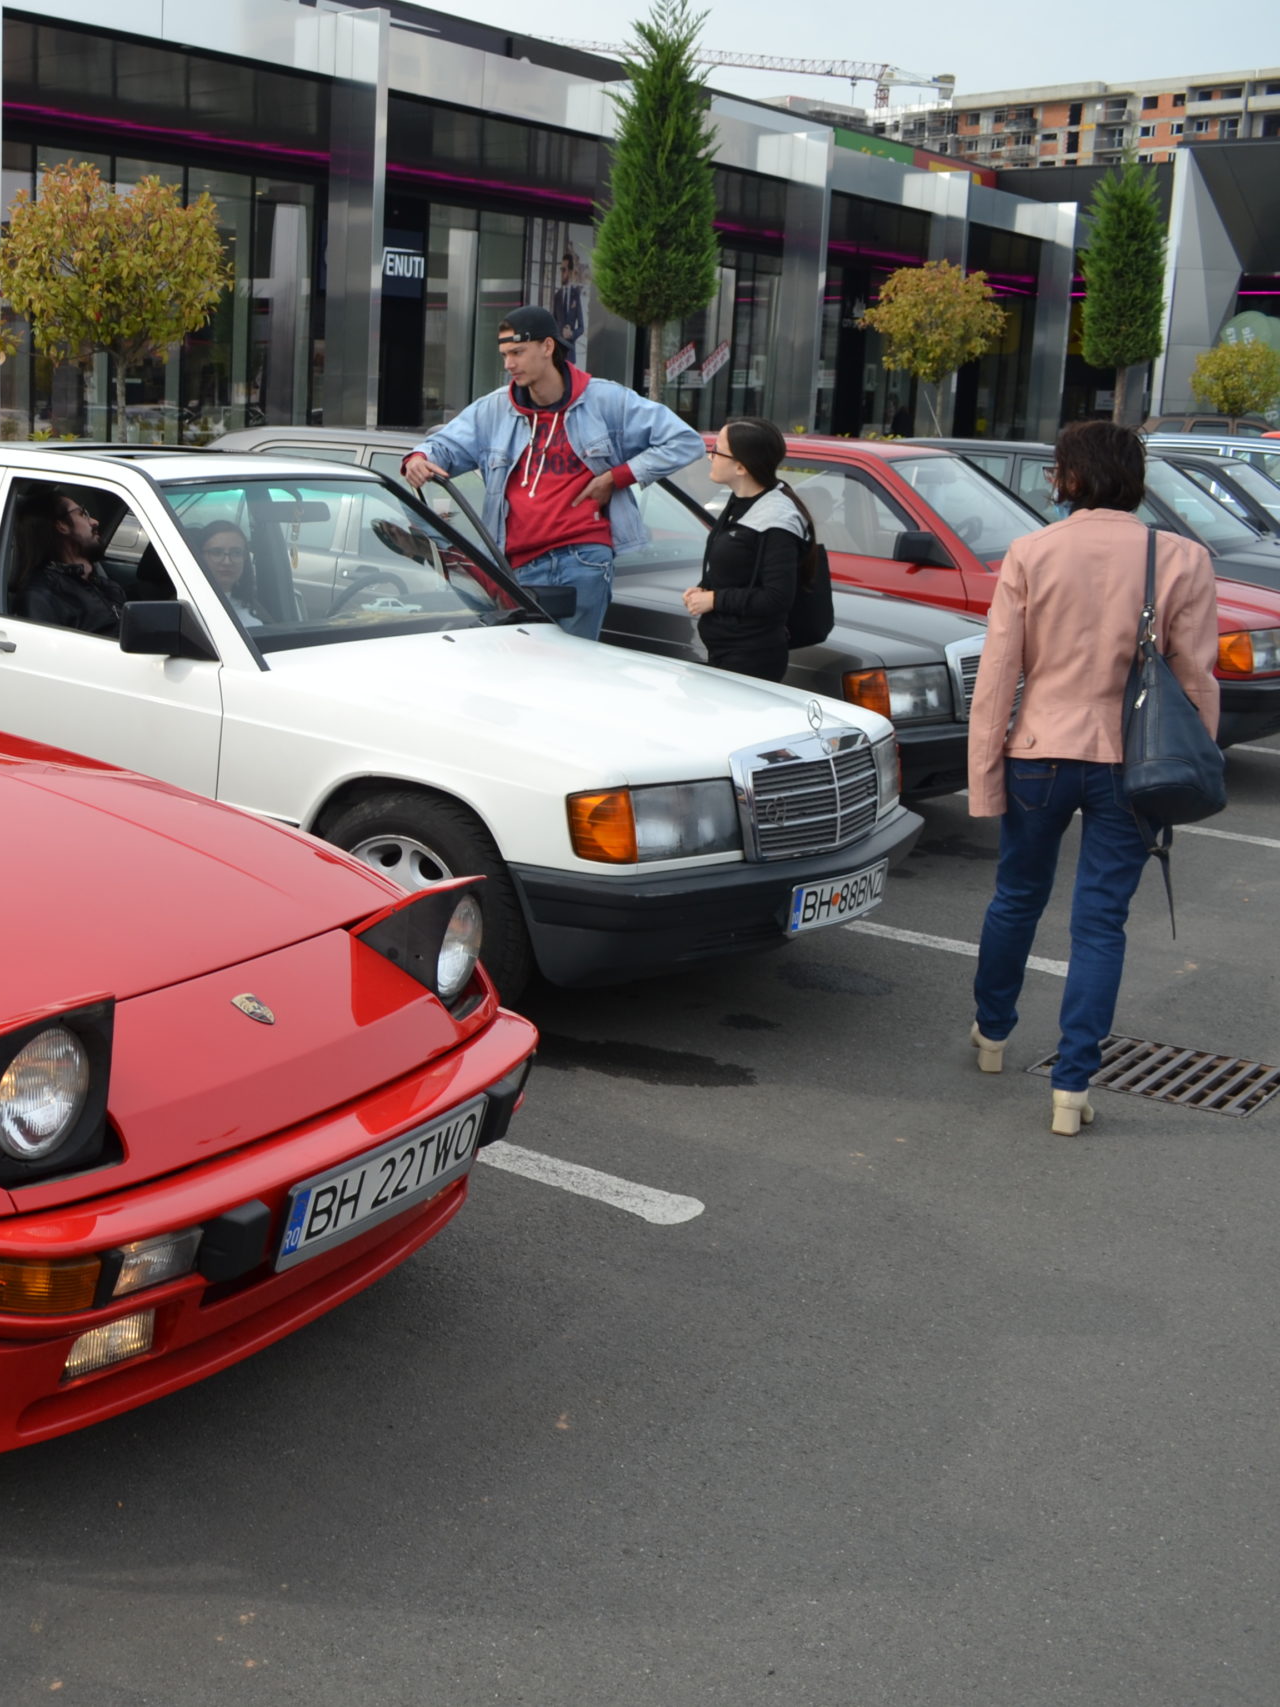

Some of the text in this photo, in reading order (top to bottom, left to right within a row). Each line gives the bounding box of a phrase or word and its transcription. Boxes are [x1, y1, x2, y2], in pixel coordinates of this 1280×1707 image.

[801, 867, 885, 923] BH 88BNZ
[304, 1113, 477, 1241] BH 22TWO
